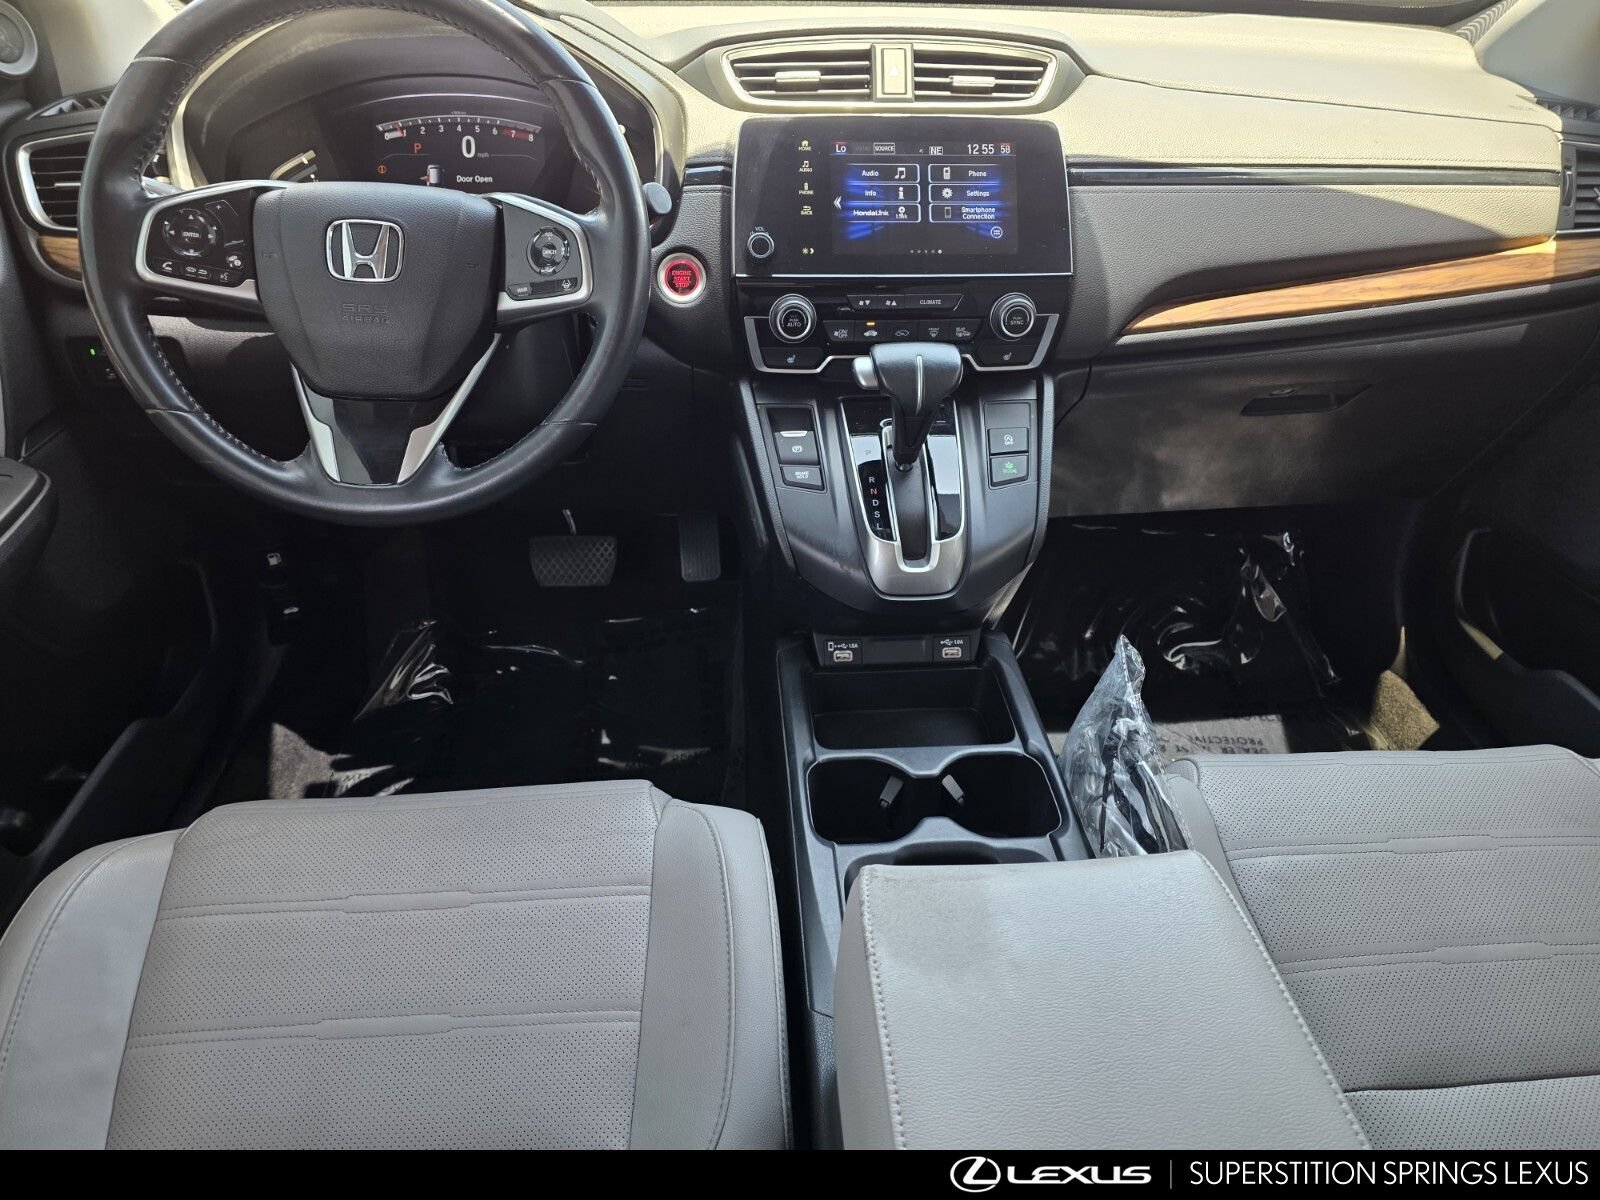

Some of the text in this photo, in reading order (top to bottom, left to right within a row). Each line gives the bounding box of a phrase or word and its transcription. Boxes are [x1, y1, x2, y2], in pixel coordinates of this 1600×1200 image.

[420, 126, 426, 135] 2
[438, 124, 444, 132] 3
[456, 124, 462, 132] 4
[475, 125, 480, 133] 5
[492, 127, 498, 135] 6
[511, 129, 516, 138] 7
[528, 133, 534, 142] 8
[414, 143, 422, 153] P
[461, 135, 476, 158] 0
[835, 144, 847, 153] Lo
[1000, 145, 1011, 154] 58
[861, 169, 879, 177] Audio
[968, 169, 987, 177] Phone
[456, 175, 493, 184] Door Open
[342, 303, 388, 314] SRS
[342, 315, 391, 324] AIRBAG
[868, 476, 876, 484] R
[870, 487, 878, 495] N
[872, 499, 880, 507] D
[874, 510, 881, 518] S
[876, 522, 882, 530] L
